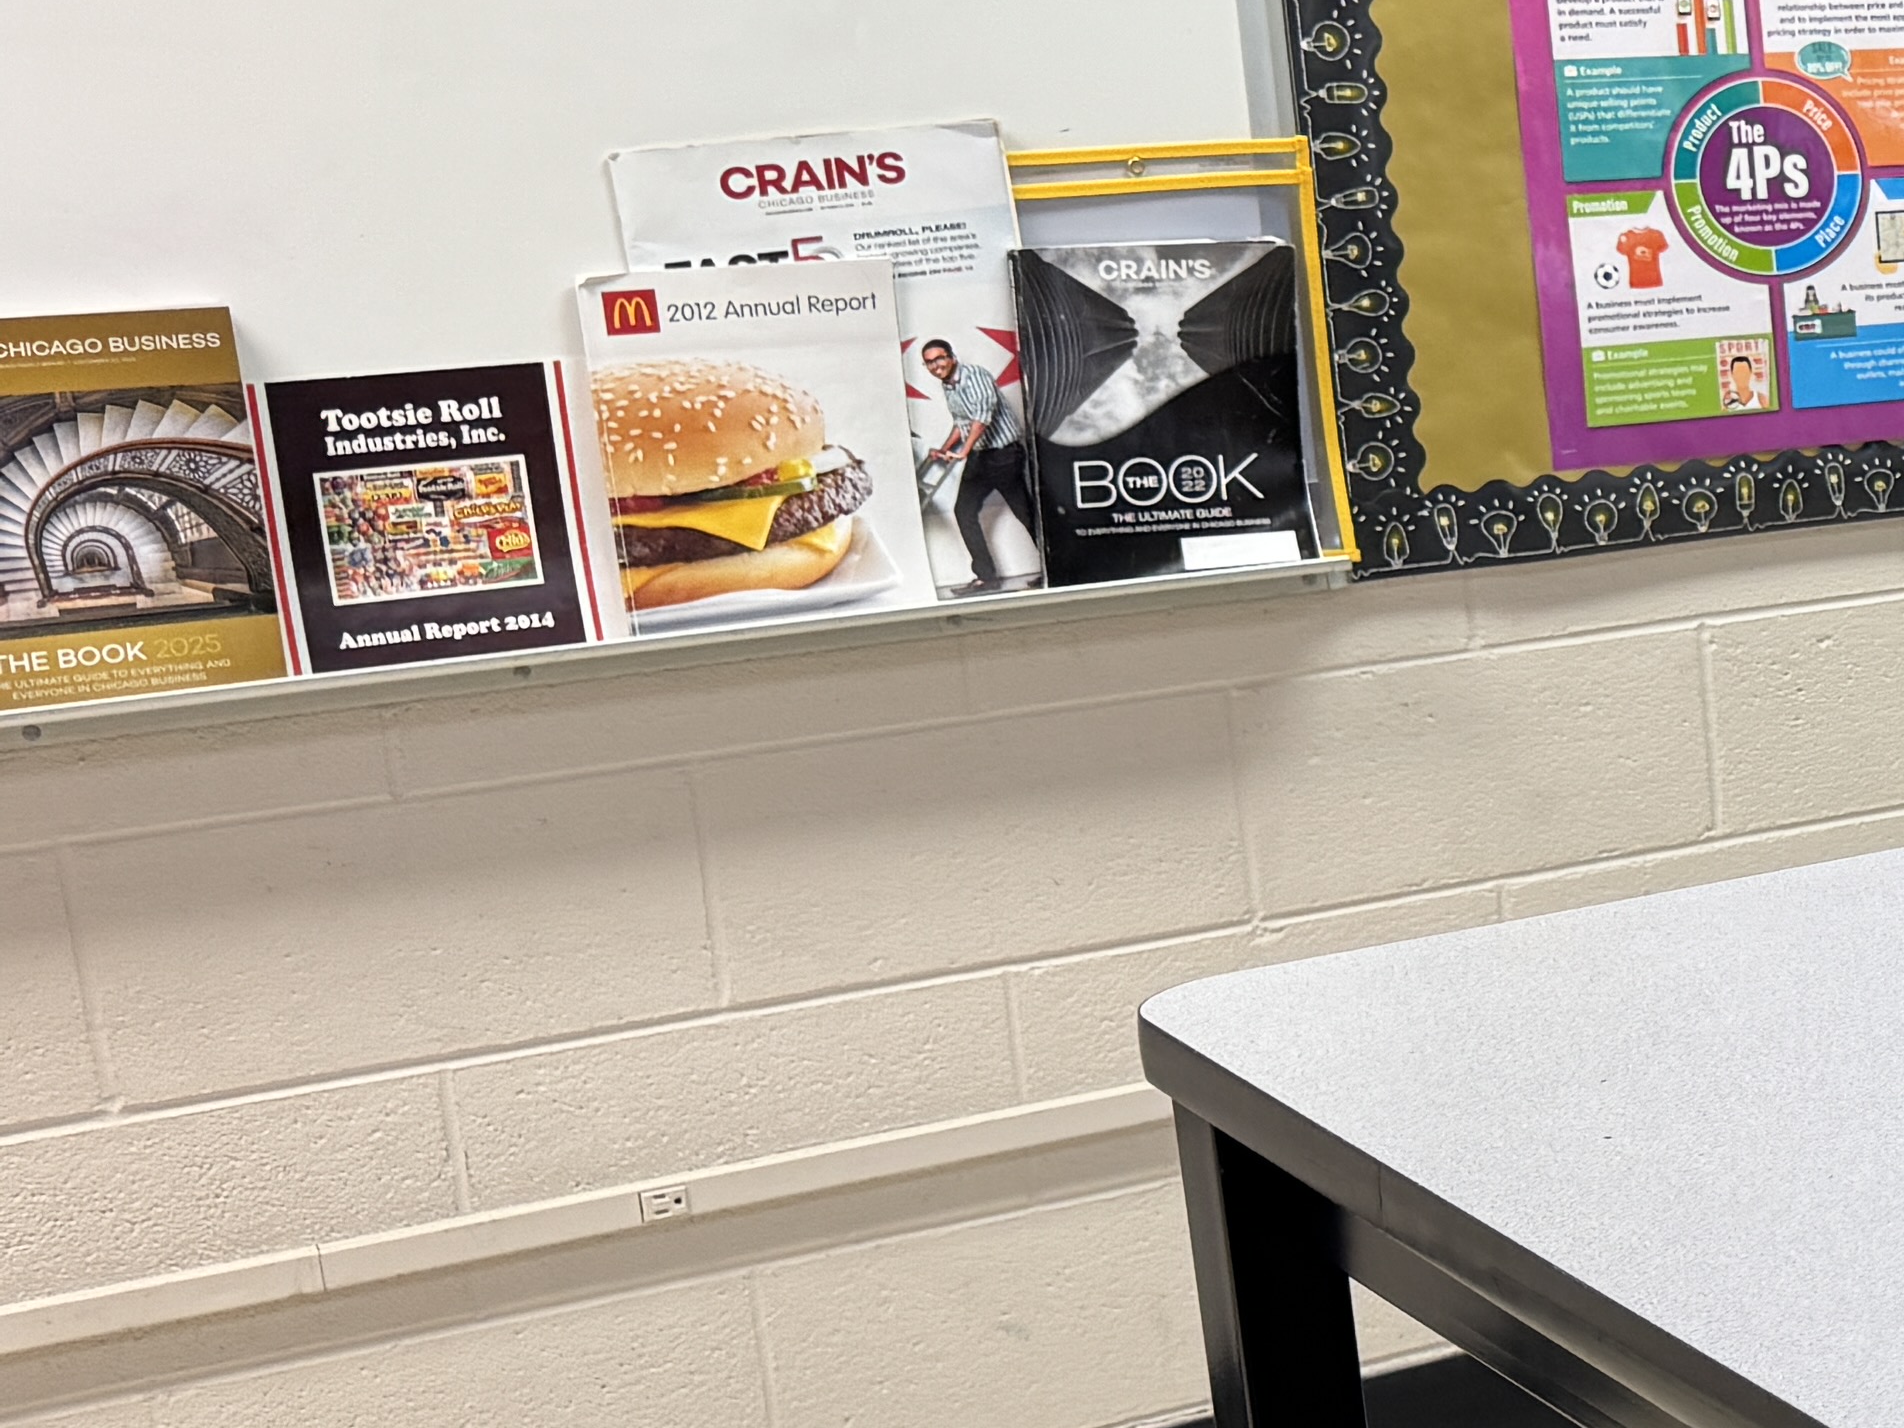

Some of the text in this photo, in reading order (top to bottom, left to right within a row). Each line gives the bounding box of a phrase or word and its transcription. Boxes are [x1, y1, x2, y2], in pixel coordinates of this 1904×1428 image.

[1682, 102, 1723, 153] Product
[1728, 119, 1765, 144] The
[1801, 99, 1834, 132] Price
[720, 151, 906, 200] CRAIN'S
[1724, 144, 1811, 202] 4Ps
[758, 190, 875, 210] CHICAGO BUSINESS
[1686, 204, 1740, 263] Promotion
[1814, 214, 1847, 249] Place
[1098, 259, 1211, 280] CRAIN'S
[667, 292, 877, 323] 2012 Annual Report
[0, 332, 220, 359] CHICAGO BUSINESS
[1719, 340, 1762, 354] SPORT
[320, 396, 502, 432] Tootsie Roll
[324, 425, 506, 456] Industries, Inc.
[1073, 452, 1265, 509] BOOK
[1126, 476, 1159, 489] THE
[1112, 506, 1232, 524] THE ULTIMATE GUIDE
[339, 612, 555, 650] Annual Report 2014
[58, 641, 146, 669] BOOK
[156, 633, 221, 659] 2025
